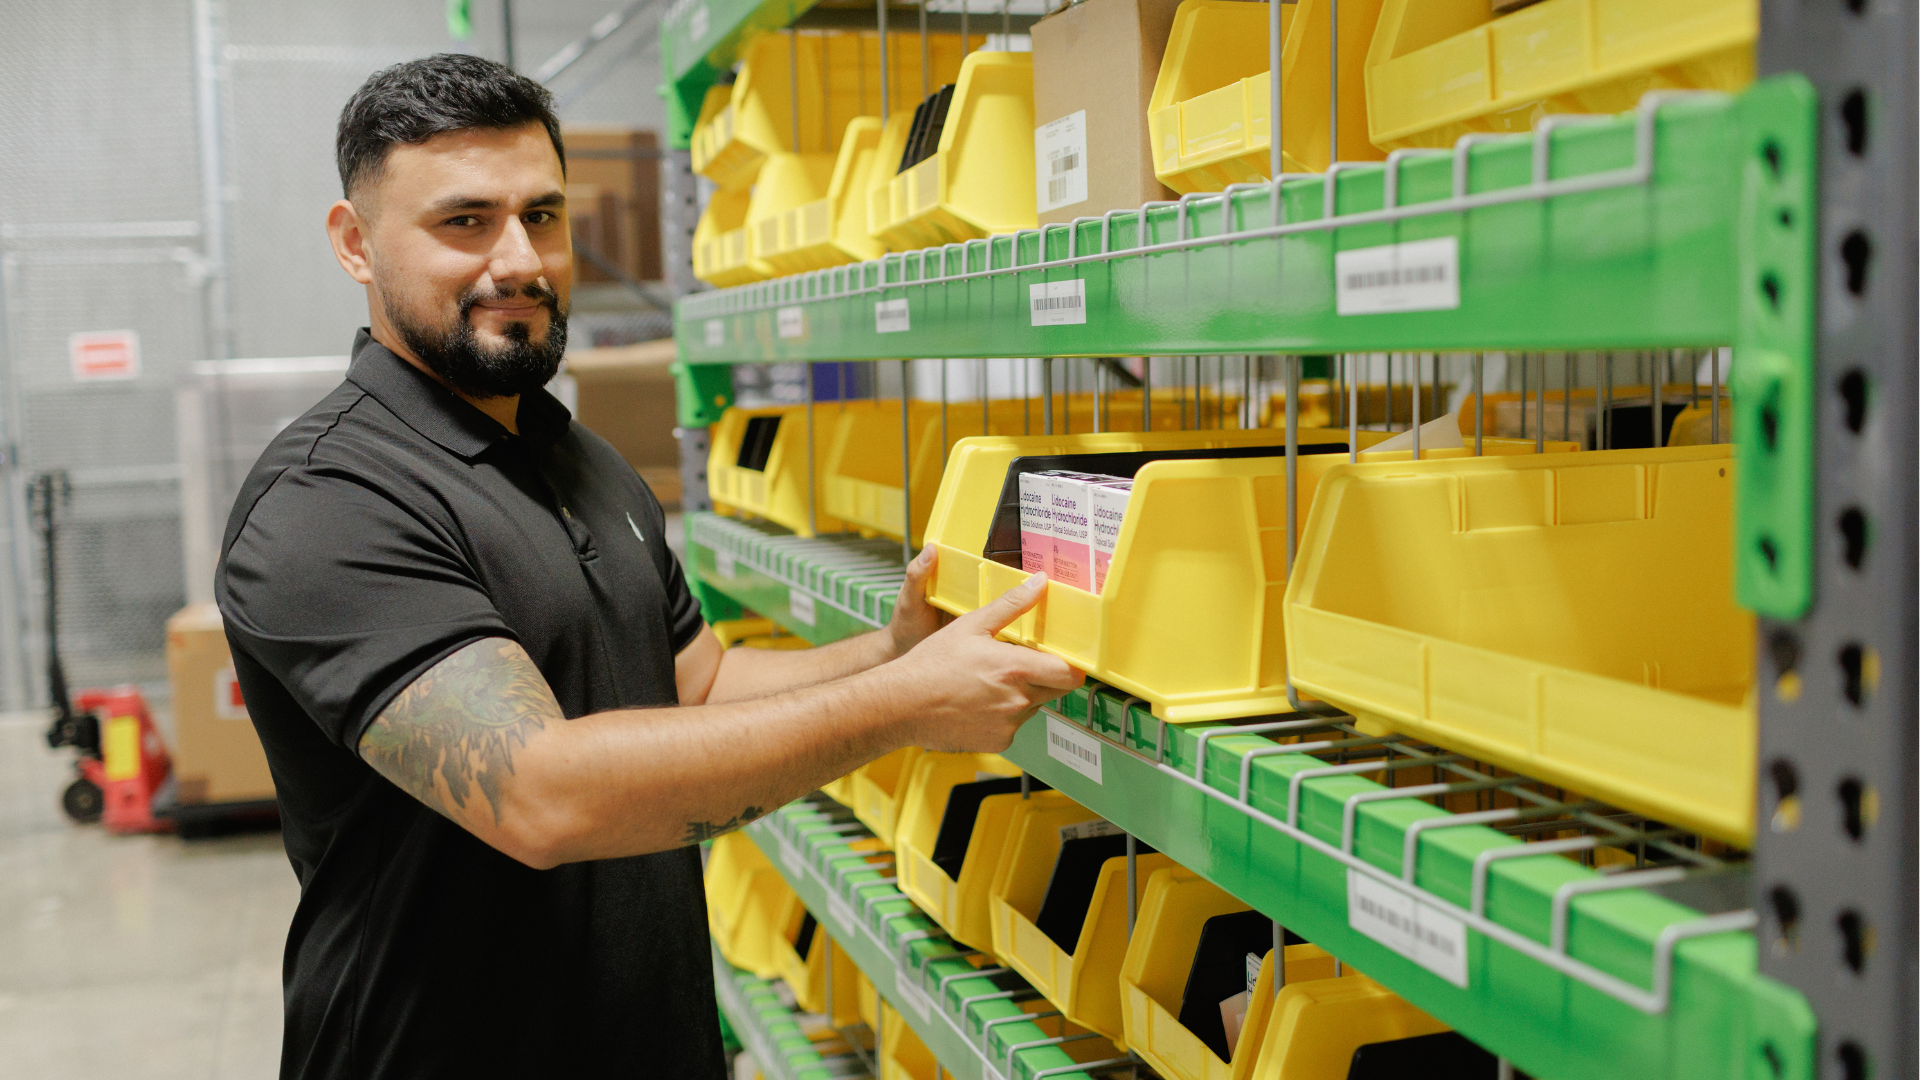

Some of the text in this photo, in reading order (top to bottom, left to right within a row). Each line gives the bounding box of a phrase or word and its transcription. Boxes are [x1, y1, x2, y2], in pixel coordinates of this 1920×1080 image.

[1020, 489, 1041, 503] Lidocaine
[1051, 494, 1076, 509] Lidocaine
[1020, 503, 1051, 519] Hydrochloride
[1051, 508, 1087, 526] Hydrochloride
[1094, 504, 1122, 521] Lidocaine
[1052, 523, 1064, 535] Topical
[1079, 530, 1087, 538] USP
[1094, 520, 1119, 537] Hydrochl
